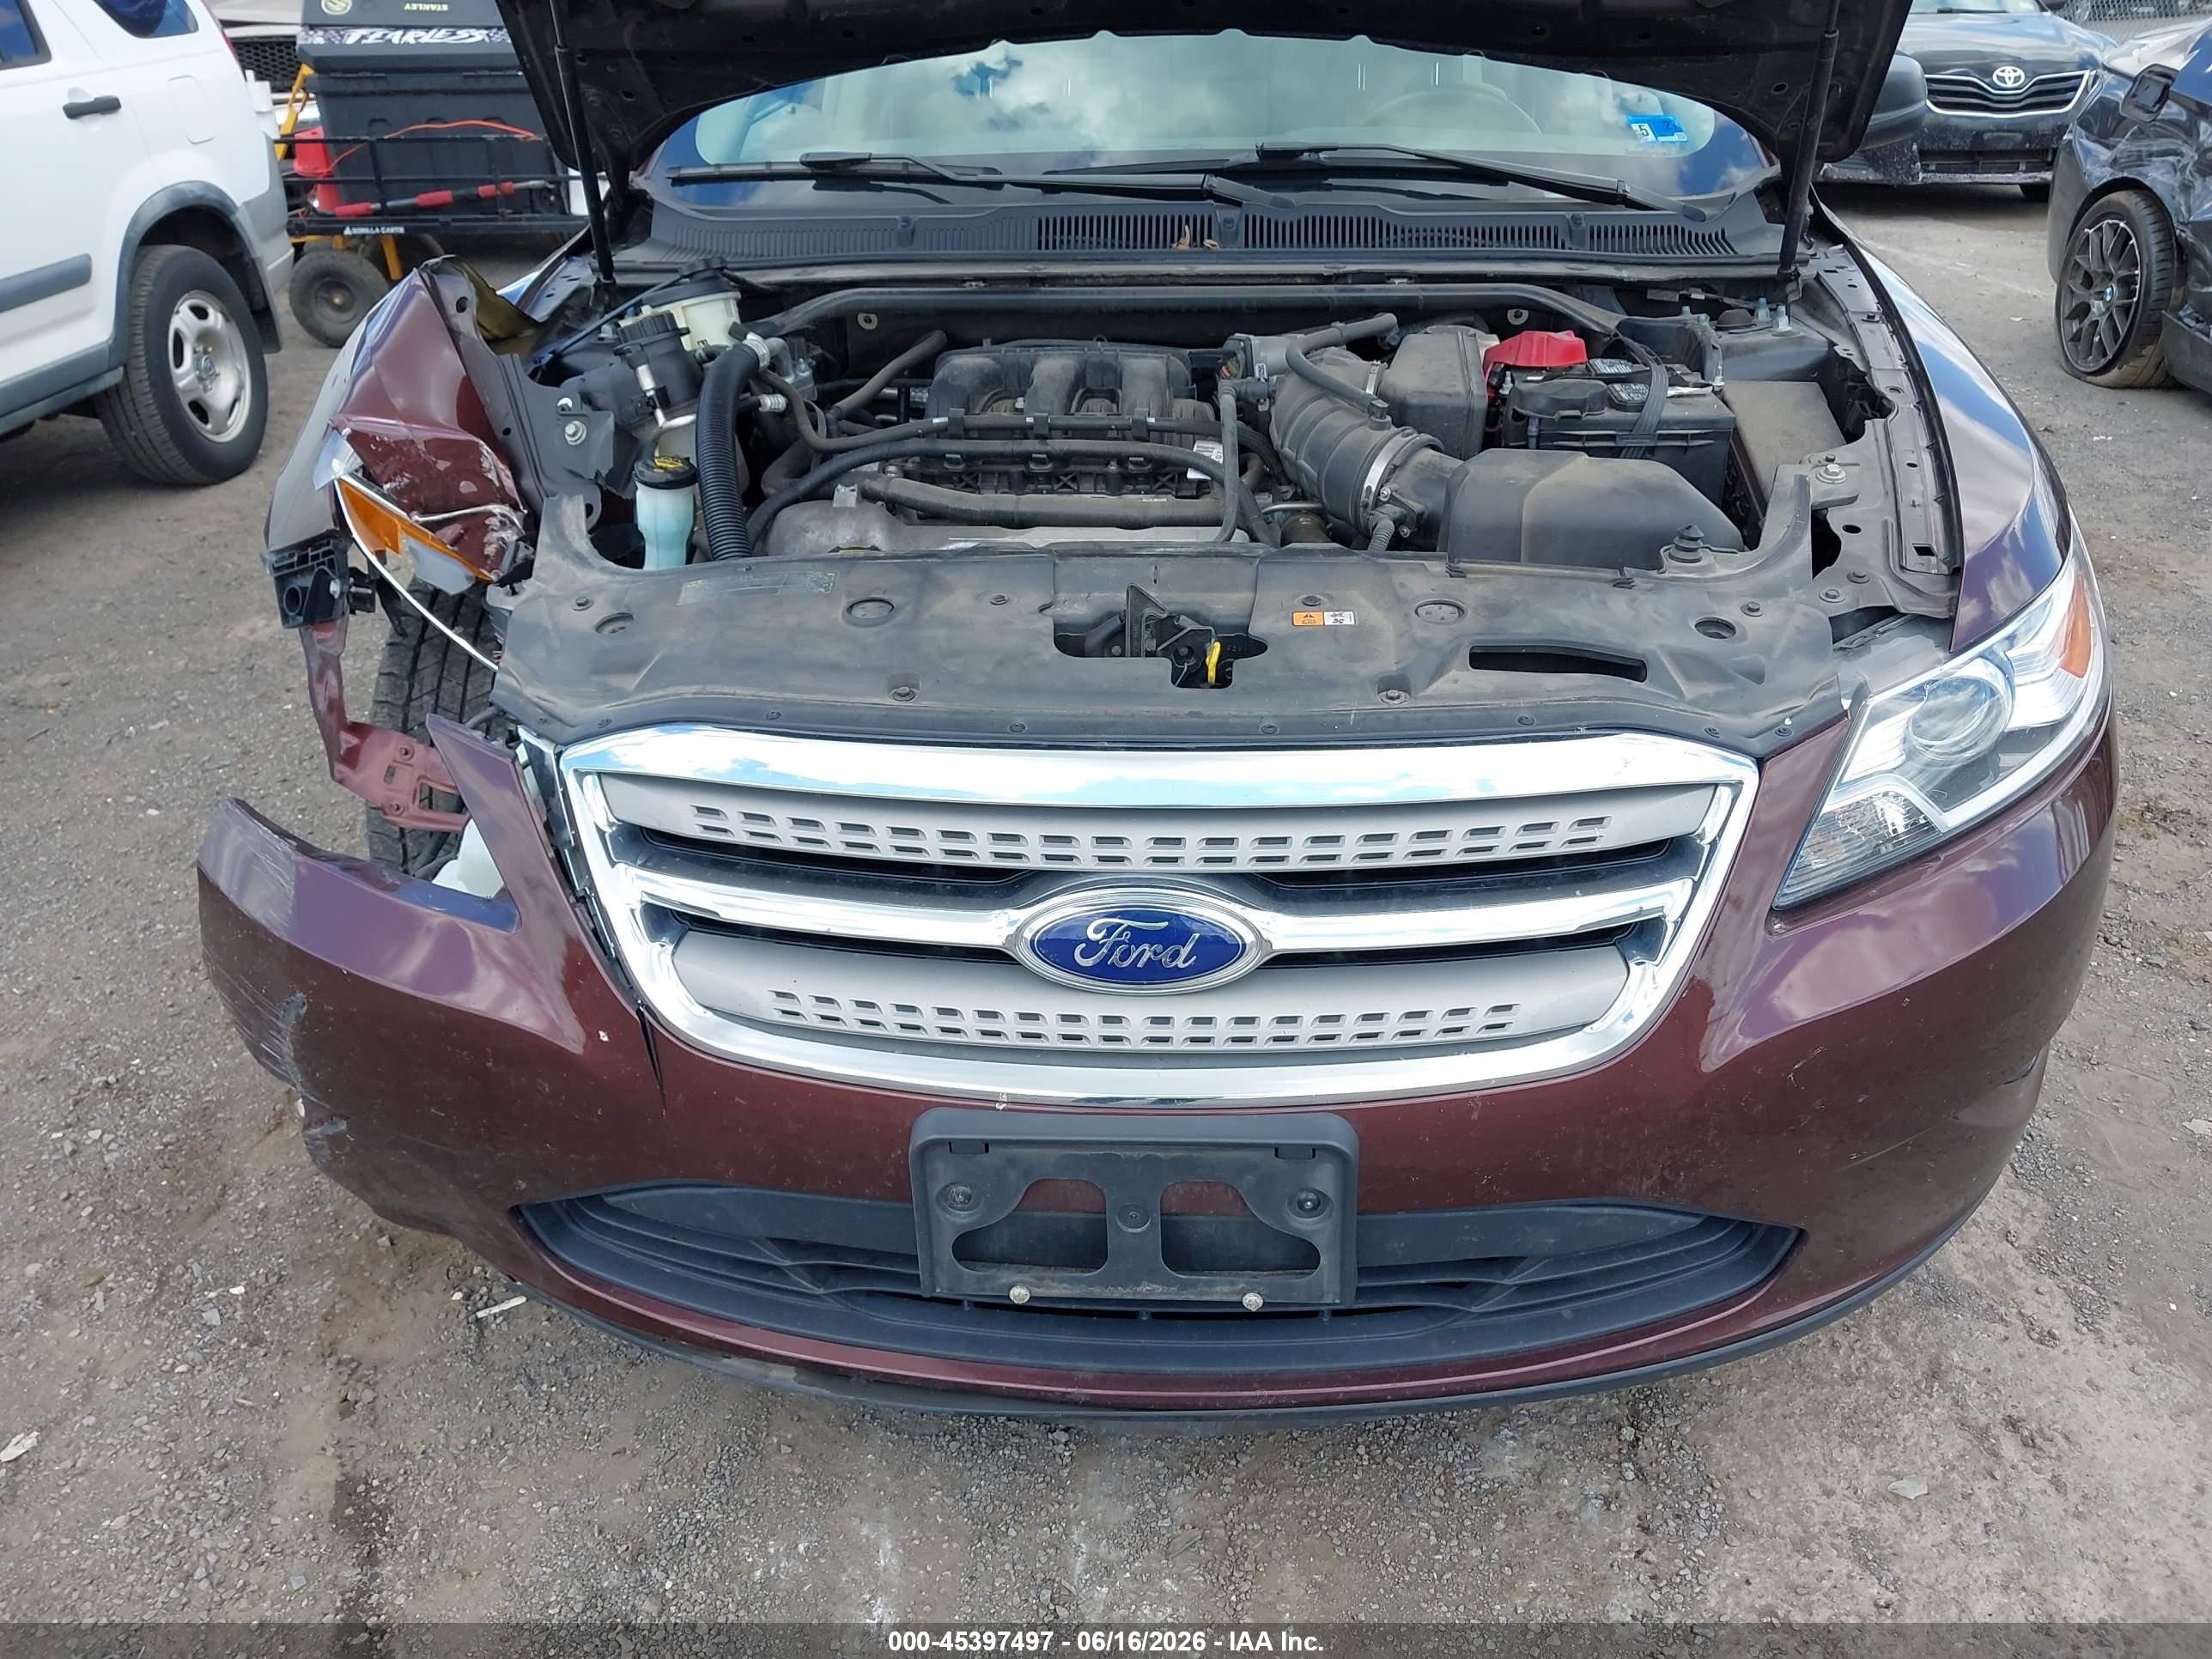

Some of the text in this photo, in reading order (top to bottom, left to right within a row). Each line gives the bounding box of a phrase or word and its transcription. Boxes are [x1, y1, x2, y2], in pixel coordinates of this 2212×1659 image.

[404, 3, 448, 12] STANLEY
[1638, 125, 1650, 137] 5
[1074, 918, 1200, 969] Ford
